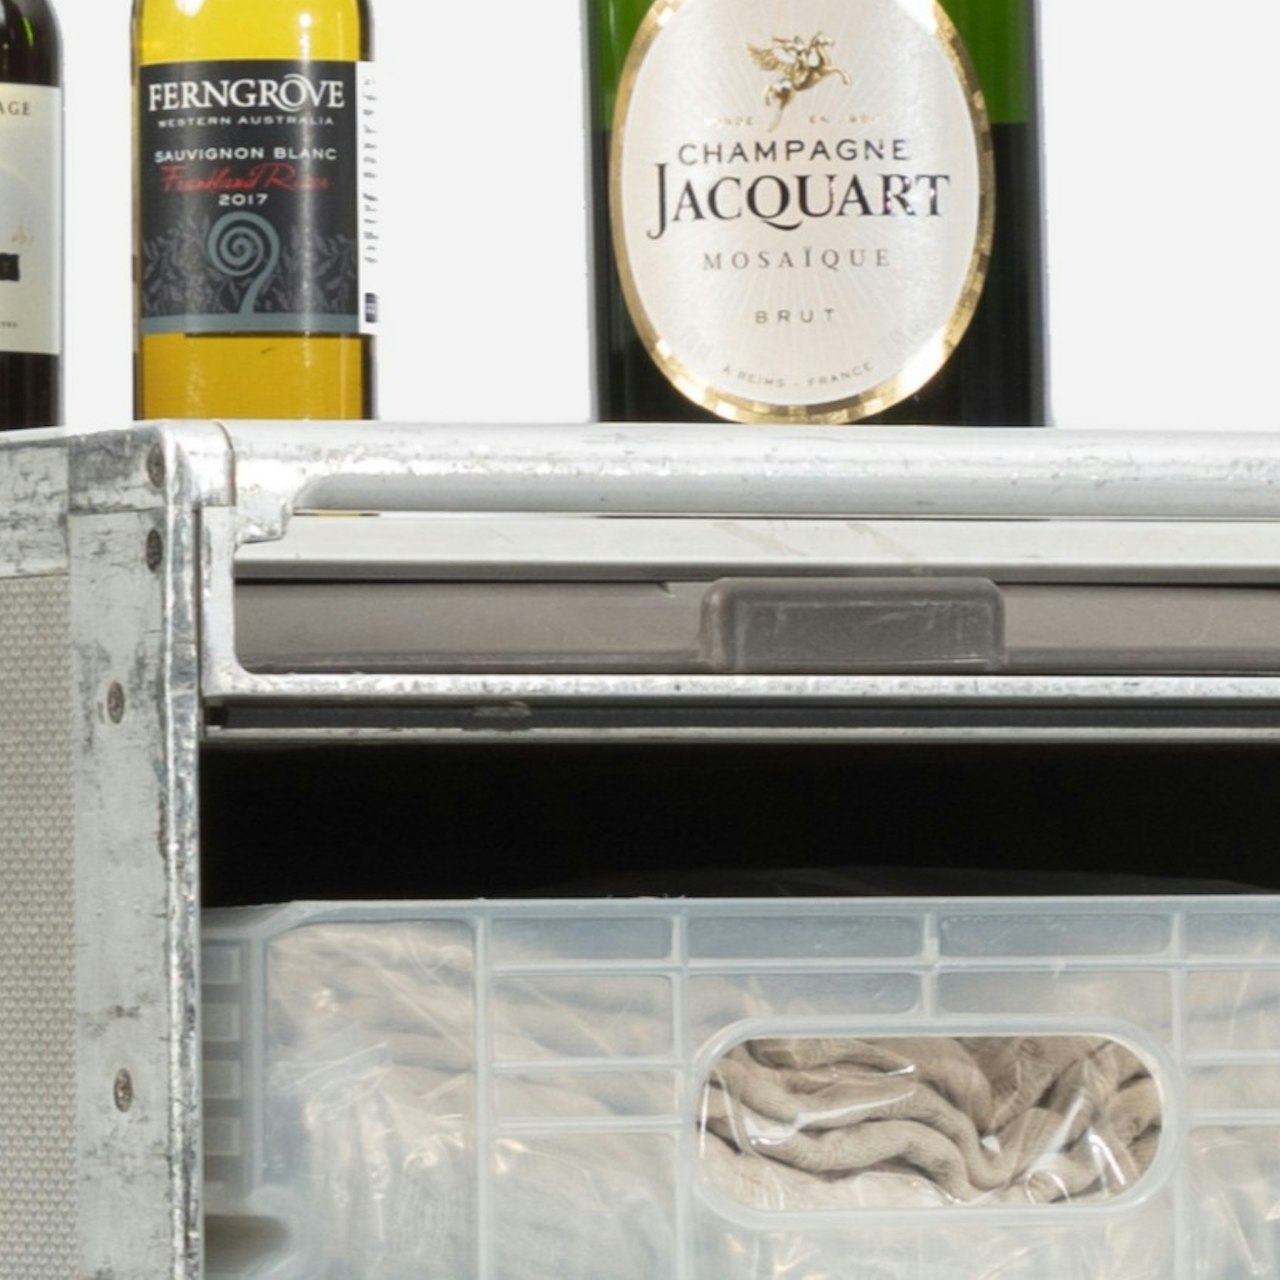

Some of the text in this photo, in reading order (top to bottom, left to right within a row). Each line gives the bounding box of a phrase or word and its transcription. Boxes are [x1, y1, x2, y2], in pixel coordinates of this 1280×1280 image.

[148, 73, 345, 112] FERNGROVE
[158, 115, 334, 129] WESTERN AUSTRALIA
[154, 146, 338, 163] SAUVIGNON BLANC
[678, 138, 913, 166] CHAMPAGNE
[218, 193, 269, 206] 2017
[646, 163, 951, 240] JACQUART
[702, 246, 892, 272] MOSAÏQUE
[755, 308, 835, 324] BRUT
